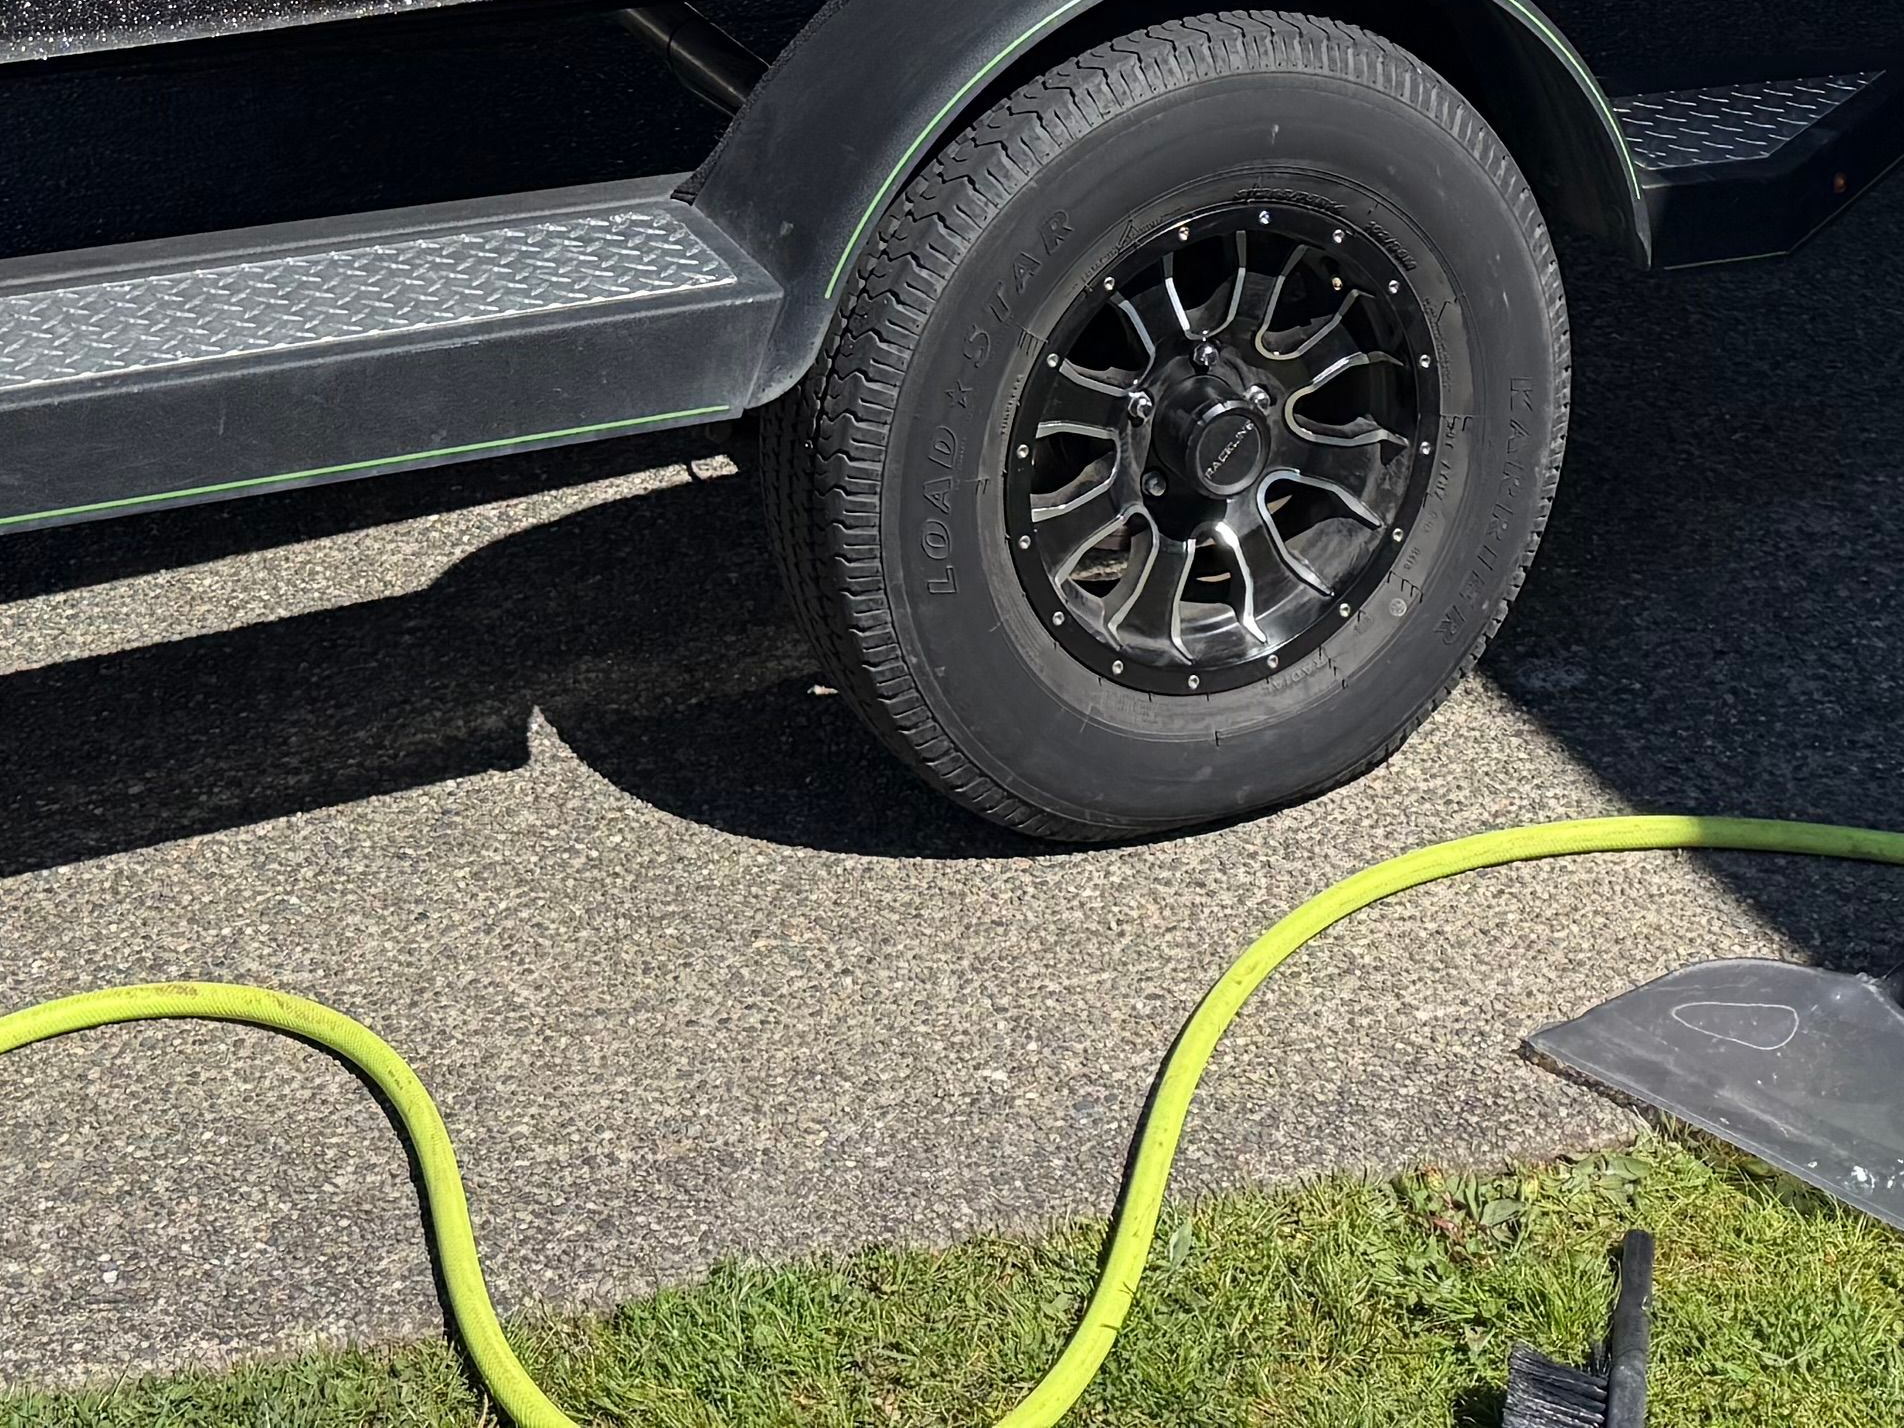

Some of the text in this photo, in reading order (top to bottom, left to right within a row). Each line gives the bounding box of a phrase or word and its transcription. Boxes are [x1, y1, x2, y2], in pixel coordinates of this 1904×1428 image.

[921, 210, 1074, 595] LOAD STAR
[1434, 377, 1534, 646] KARRIER
